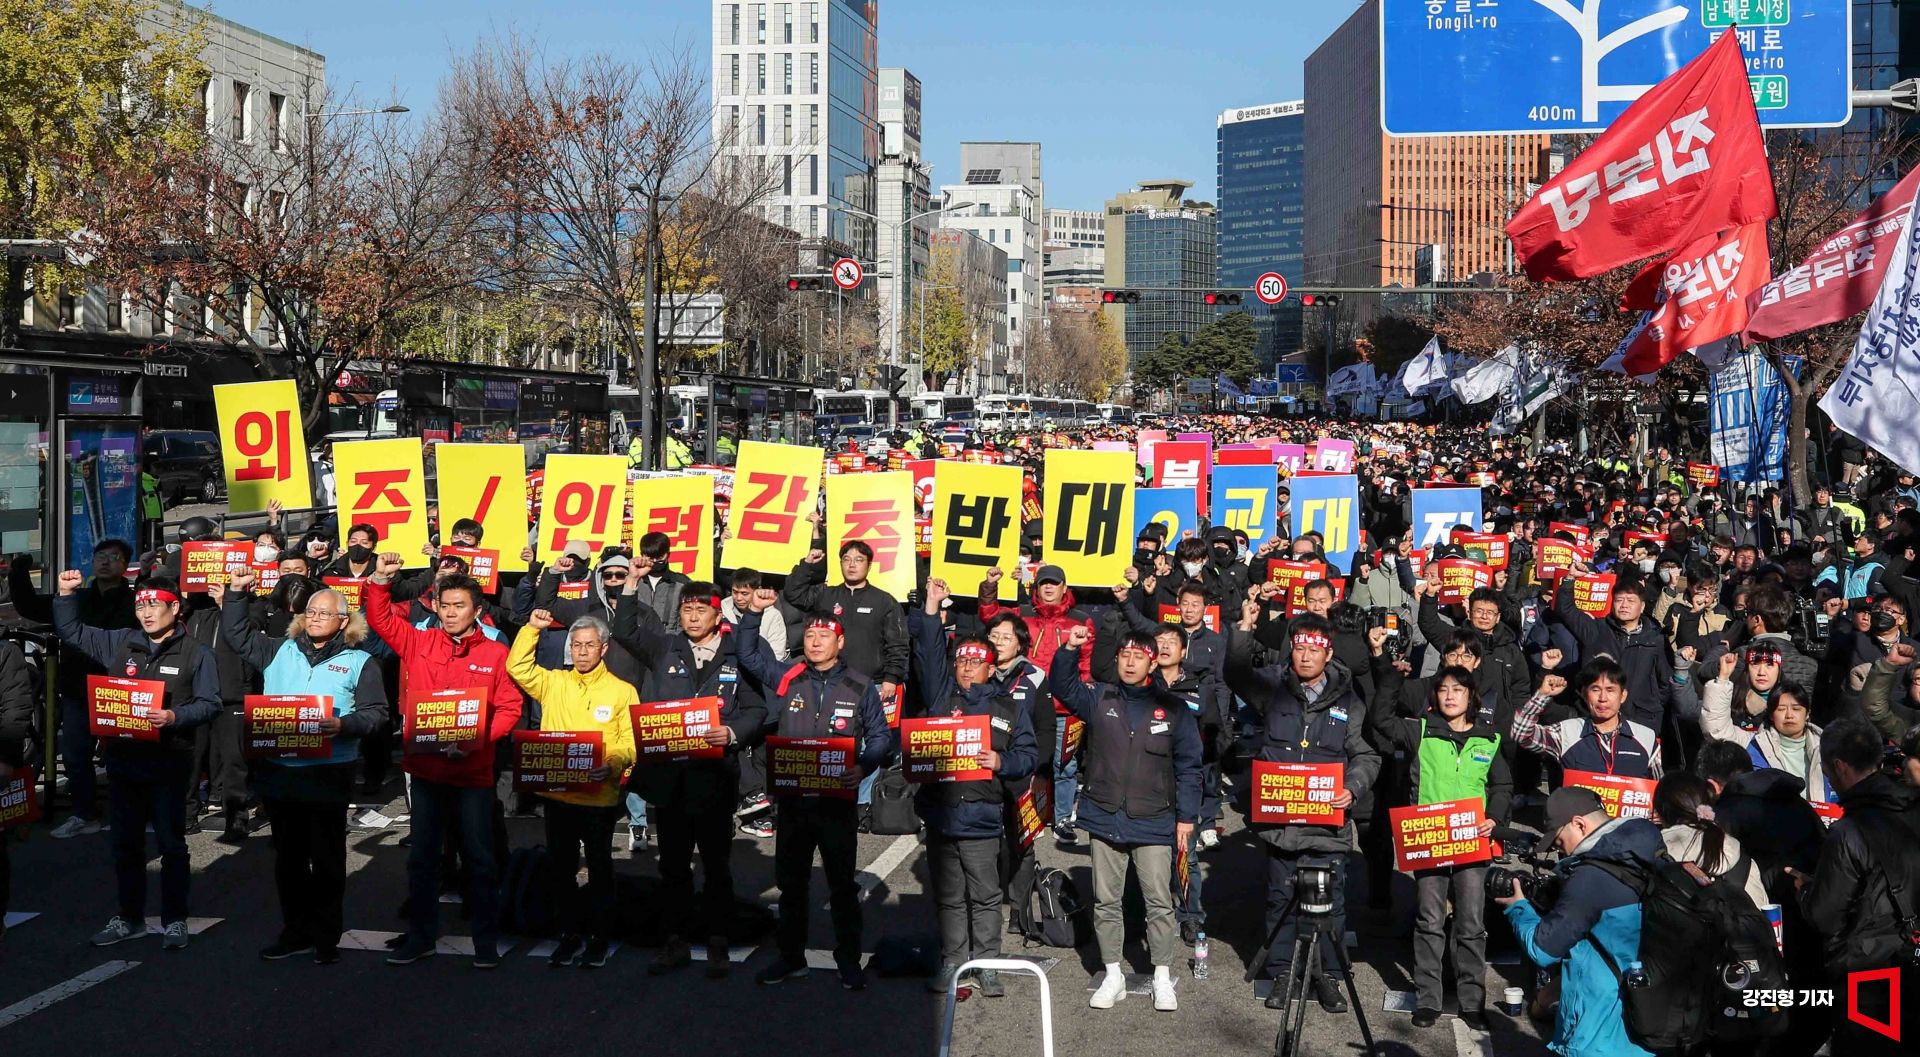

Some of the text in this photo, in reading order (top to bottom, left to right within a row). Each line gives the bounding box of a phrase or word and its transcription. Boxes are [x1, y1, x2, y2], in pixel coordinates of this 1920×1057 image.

[1427, 14, 1497, 32] Tongil-ro
[1528, 106, 1576, 121] 400m
[1262, 281, 1281, 296] 50
[234, 410, 290, 482] 외
[352, 469, 411, 541] 주
[551, 482, 616, 552] 인
[647, 504, 704, 575] 력
[737, 472, 808, 544] 감
[840, 500, 901, 573] 축
[944, 494, 1011, 567] 반
[1053, 483, 1126, 556] 대
[1225, 488, 1268, 539] 교
[1302, 498, 1352, 554] 대
[95, 687, 154, 704] 안전인력 충원!
[96, 701, 130, 715] 노사합의
[252, 707, 323, 720] 안전인력 충원!
[416, 700, 480, 715] 안전인력 충원!
[416, 715, 456, 729] 노사합의
[640, 709, 709, 727] 안전인력 충원!
[252, 721, 296, 733] 노사합의
[641, 727, 683, 740] 노사합의
[910, 728, 981, 744] 안전인력 충원!
[521, 742, 594, 756] 안전인력 충원!
[911, 744, 953, 758] 노사합의
[521, 757, 564, 769] 노사합의
[800, 776, 844, 789] 임금인상
[1261, 774, 1334, 789] 안전인력 충원!
[1261, 788, 1305, 801] 노사합의
[1622, 790, 1651, 805] 충원!
[1401, 811, 1475, 832] 안전인력 충원!
[1403, 830, 1448, 847] 노사합의
